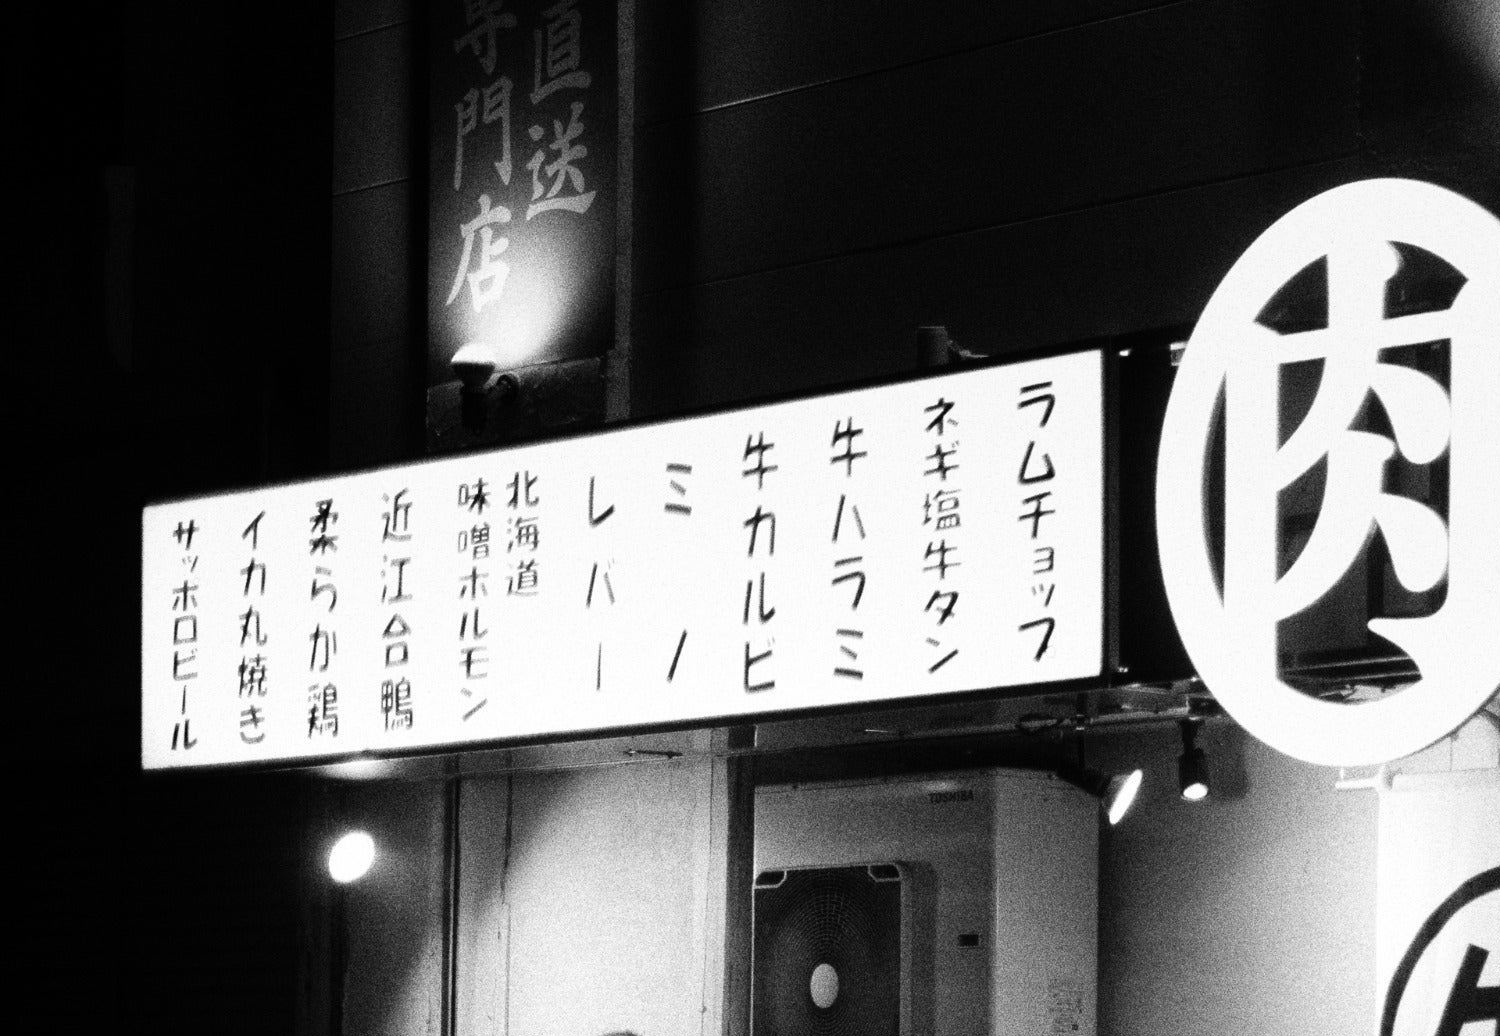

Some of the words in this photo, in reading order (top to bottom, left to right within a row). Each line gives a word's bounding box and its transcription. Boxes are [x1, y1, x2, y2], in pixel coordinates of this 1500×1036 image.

[526, 0, 597, 221] 直送
[171, 520, 199, 750] サッポロビール
[238, 511, 267, 744] イカ丸焼き
[308, 498, 338, 738] 柔らか鶏
[381, 489, 413, 731] 近江合鴨
[458, 477, 489, 720] 味噌ホルモン
[507, 470, 540, 597] 北海道
[585, 476, 615, 691] レバー
[664, 463, 693, 683] ミノ
[741, 431, 779, 693] 牛カルビ
[830, 416, 868, 680] 牛ハラミ
[922, 397, 961, 673] ネギ塩牛タン
